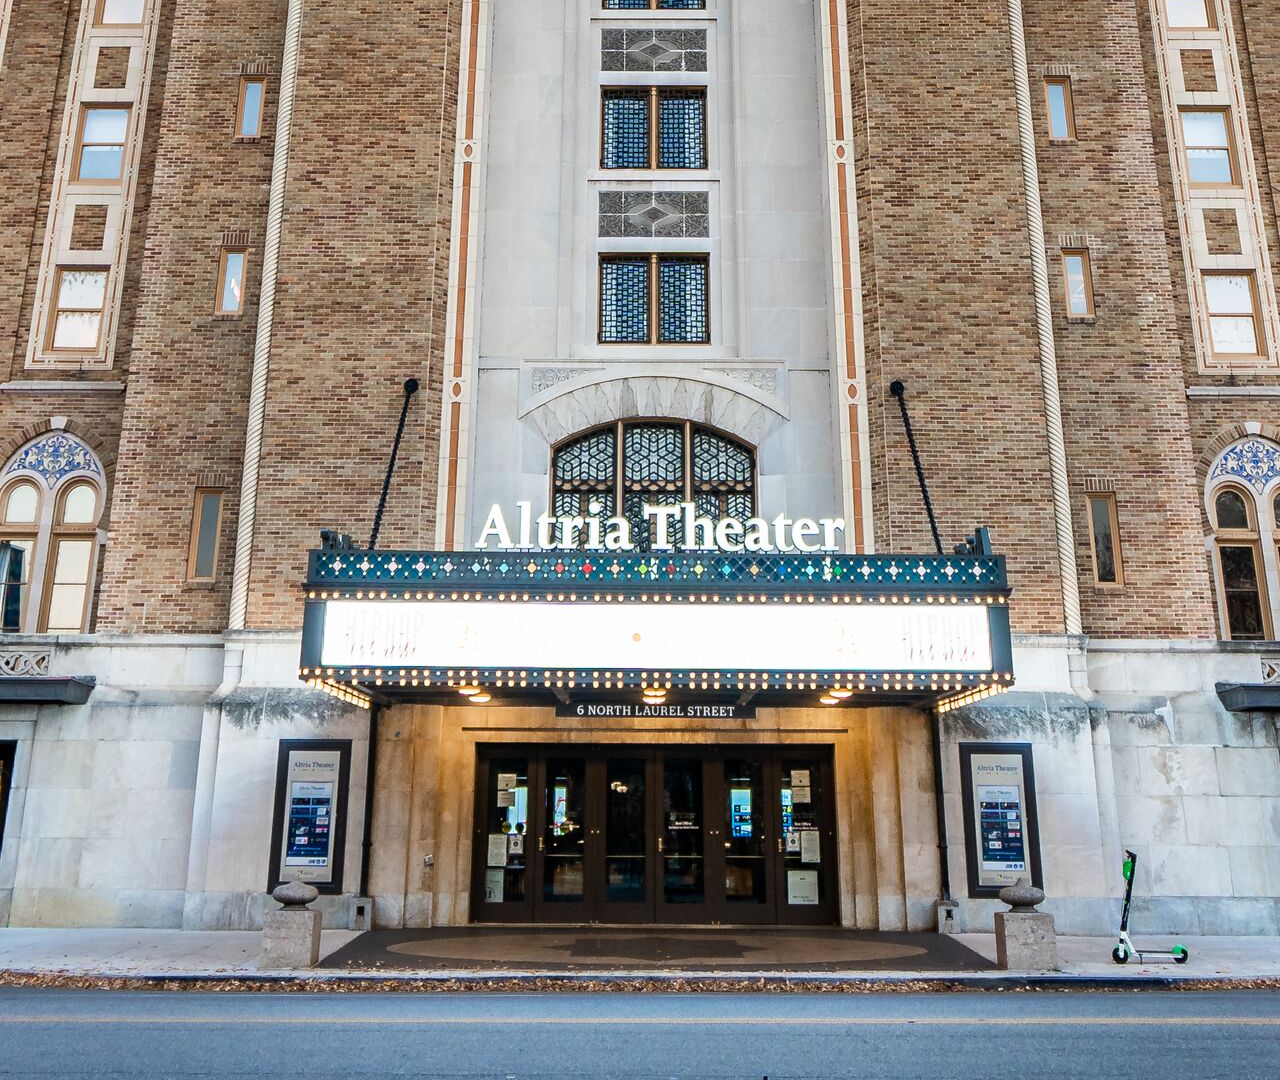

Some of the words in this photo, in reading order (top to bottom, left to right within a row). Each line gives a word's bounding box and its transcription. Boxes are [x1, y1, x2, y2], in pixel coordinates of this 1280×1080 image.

[475, 501, 635, 552] Altria
[643, 502, 846, 552] Theater
[576, 704, 585, 716] 6
[587, 705, 631, 716] NORTH
[635, 705, 685, 717] LAUREL
[687, 706, 736, 717] STREET
